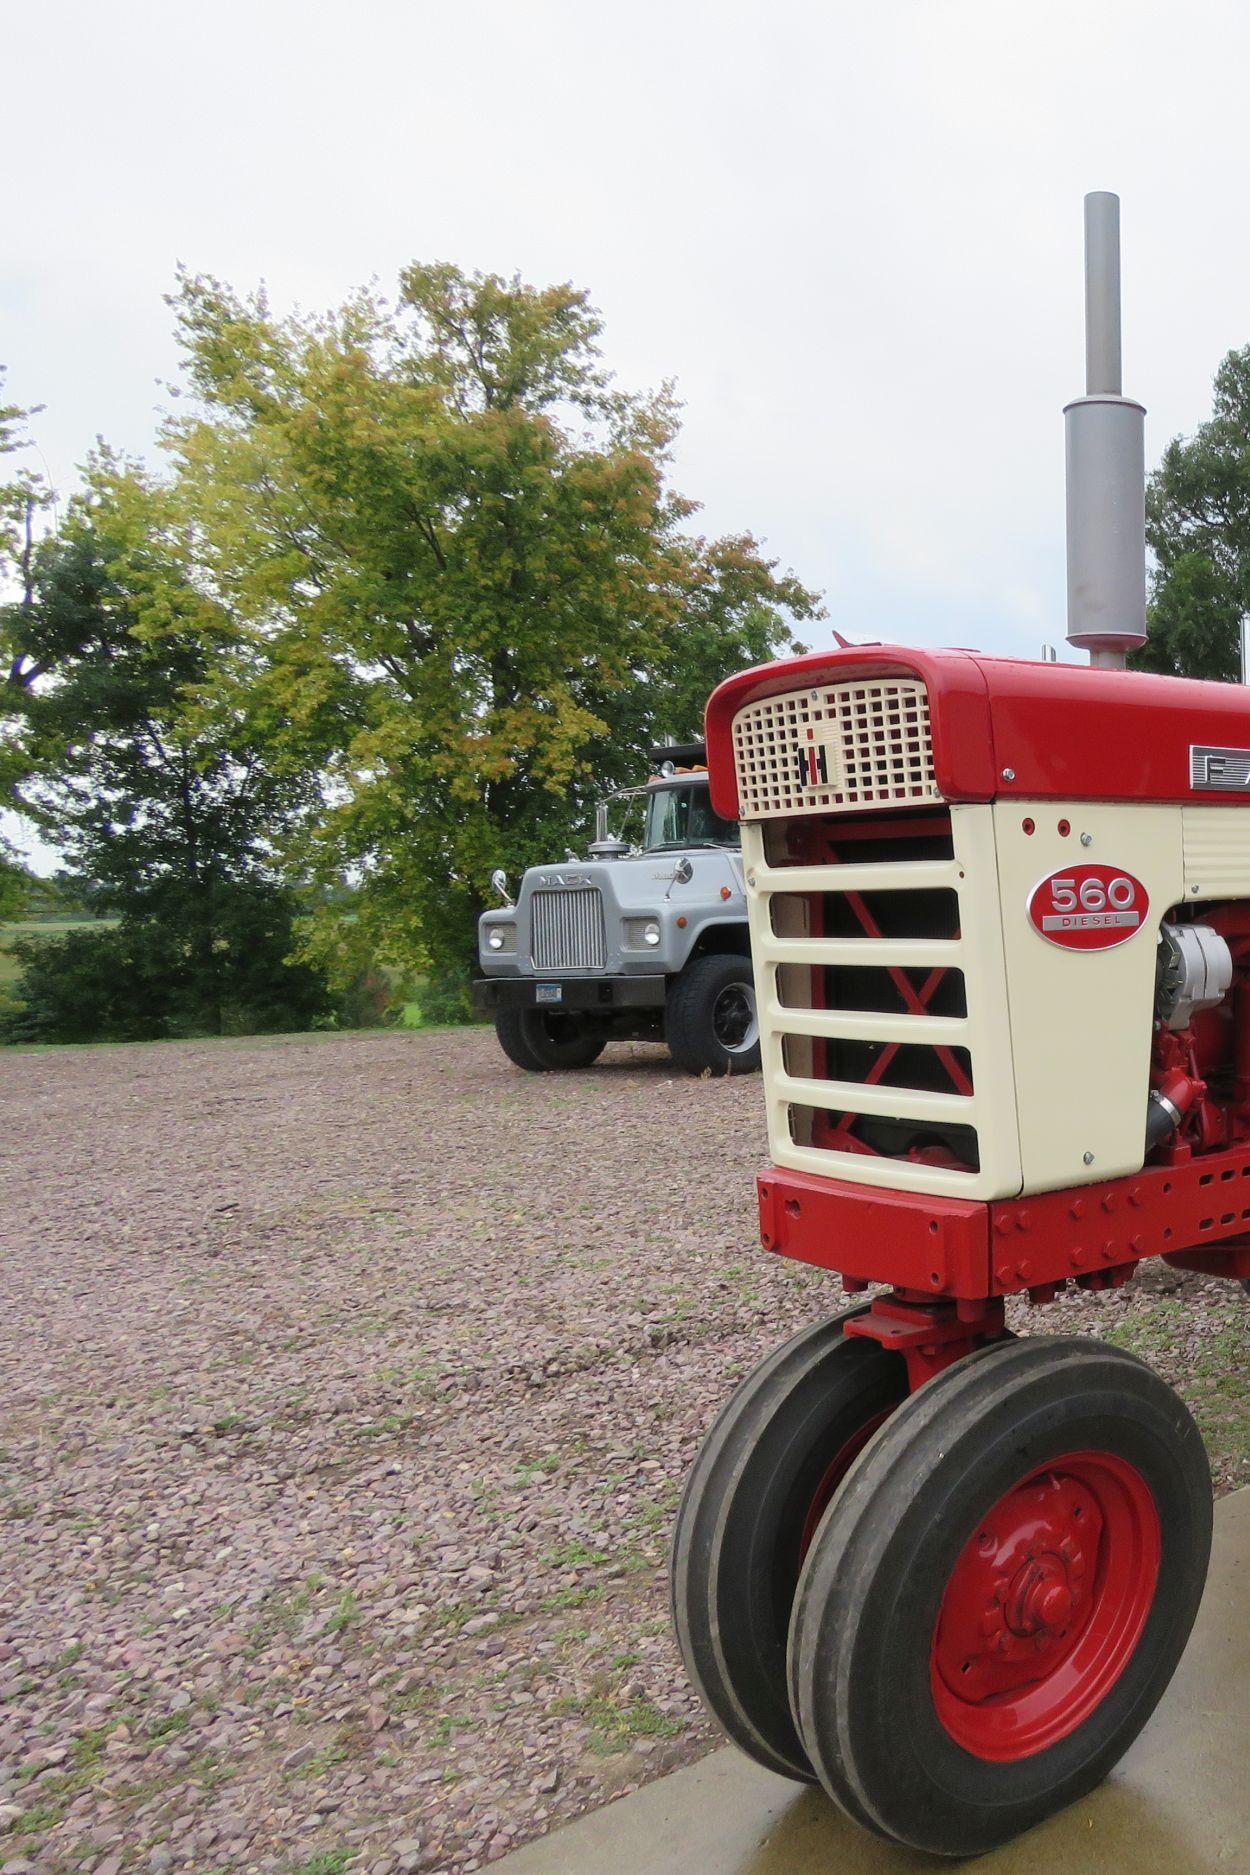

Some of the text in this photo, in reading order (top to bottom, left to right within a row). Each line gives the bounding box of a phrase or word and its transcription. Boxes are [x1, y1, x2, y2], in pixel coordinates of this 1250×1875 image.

[538, 874, 593, 887] MACK
[1051, 877, 1135, 913] 560
[1062, 915, 1121, 927] DIESEL
